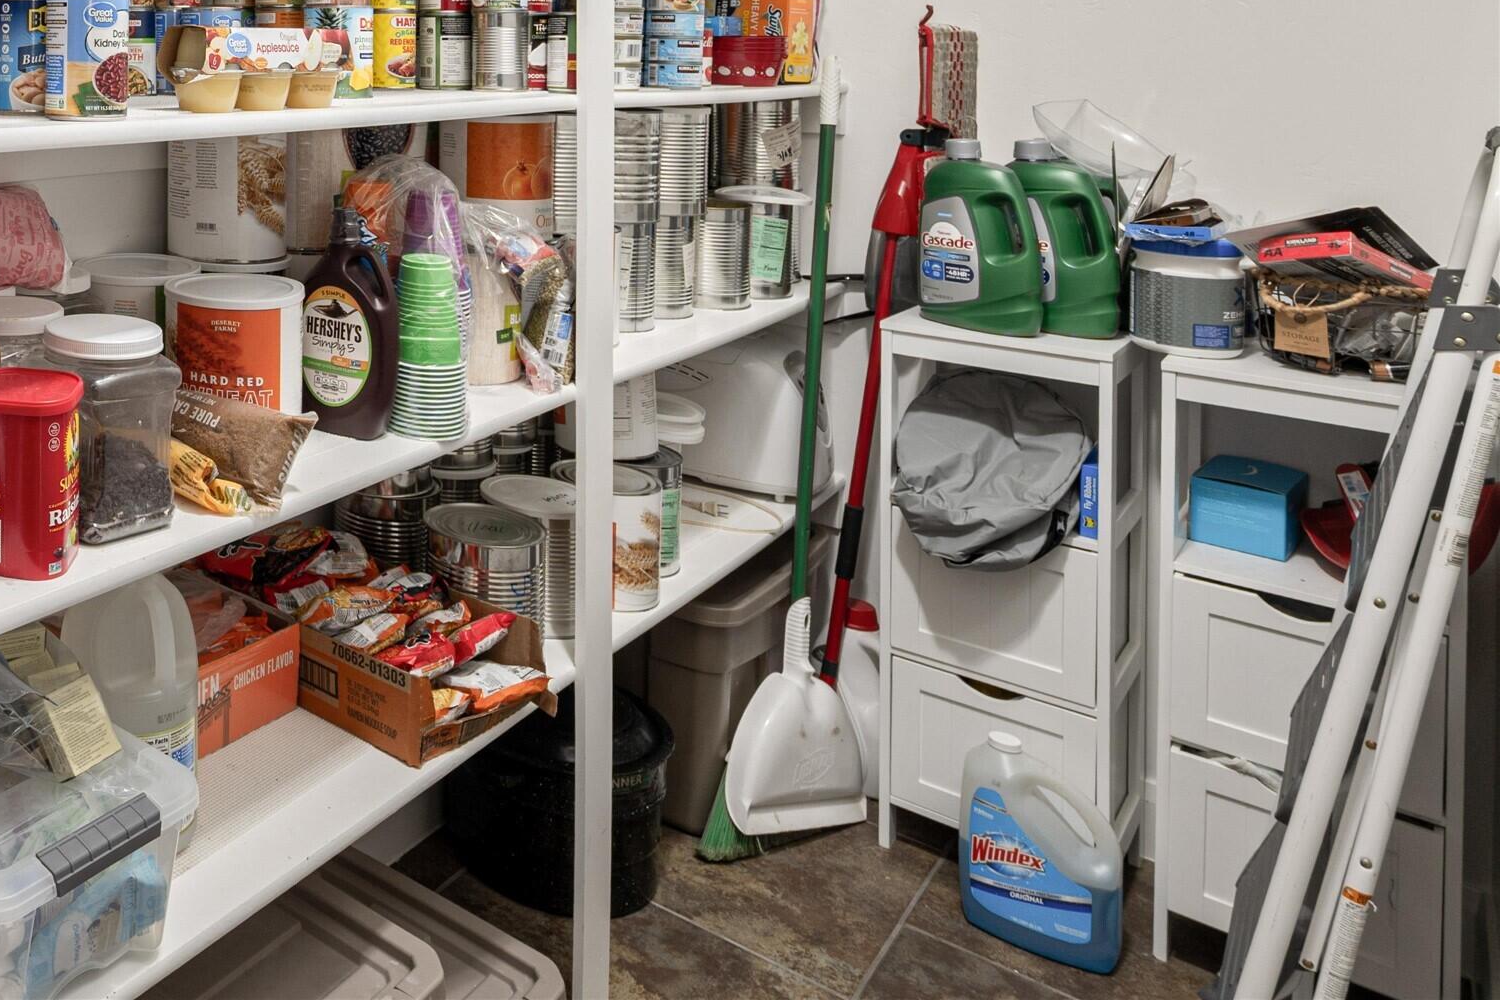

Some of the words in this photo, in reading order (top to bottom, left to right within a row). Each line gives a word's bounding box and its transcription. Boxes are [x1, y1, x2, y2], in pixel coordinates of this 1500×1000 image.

[88, 7, 114, 18] Great
[94, 15, 114, 24] Value
[112, 29, 127, 39] Dark
[93, 38, 122, 50] Kidney
[256, 42, 299, 55] Applesauce
[923, 233, 973, 249] Cascade
[1264, 247, 1284, 259] AA
[210, 319, 242, 327] DESERET
[214, 325, 238, 334] FARMS
[306, 316, 362, 343] HERSHEY'S
[312, 336, 345, 356] Simply
[190, 371, 229, 386] HARD
[235, 375, 264, 387] RED
[233, 665, 266, 691] CHICKEN
[268, 650, 294, 674] FLAVOR
[332, 641, 406, 688] 70662-01303
[970, 834, 1046, 872] Windex
[1008, 890, 1044, 906] ORIGINAL
